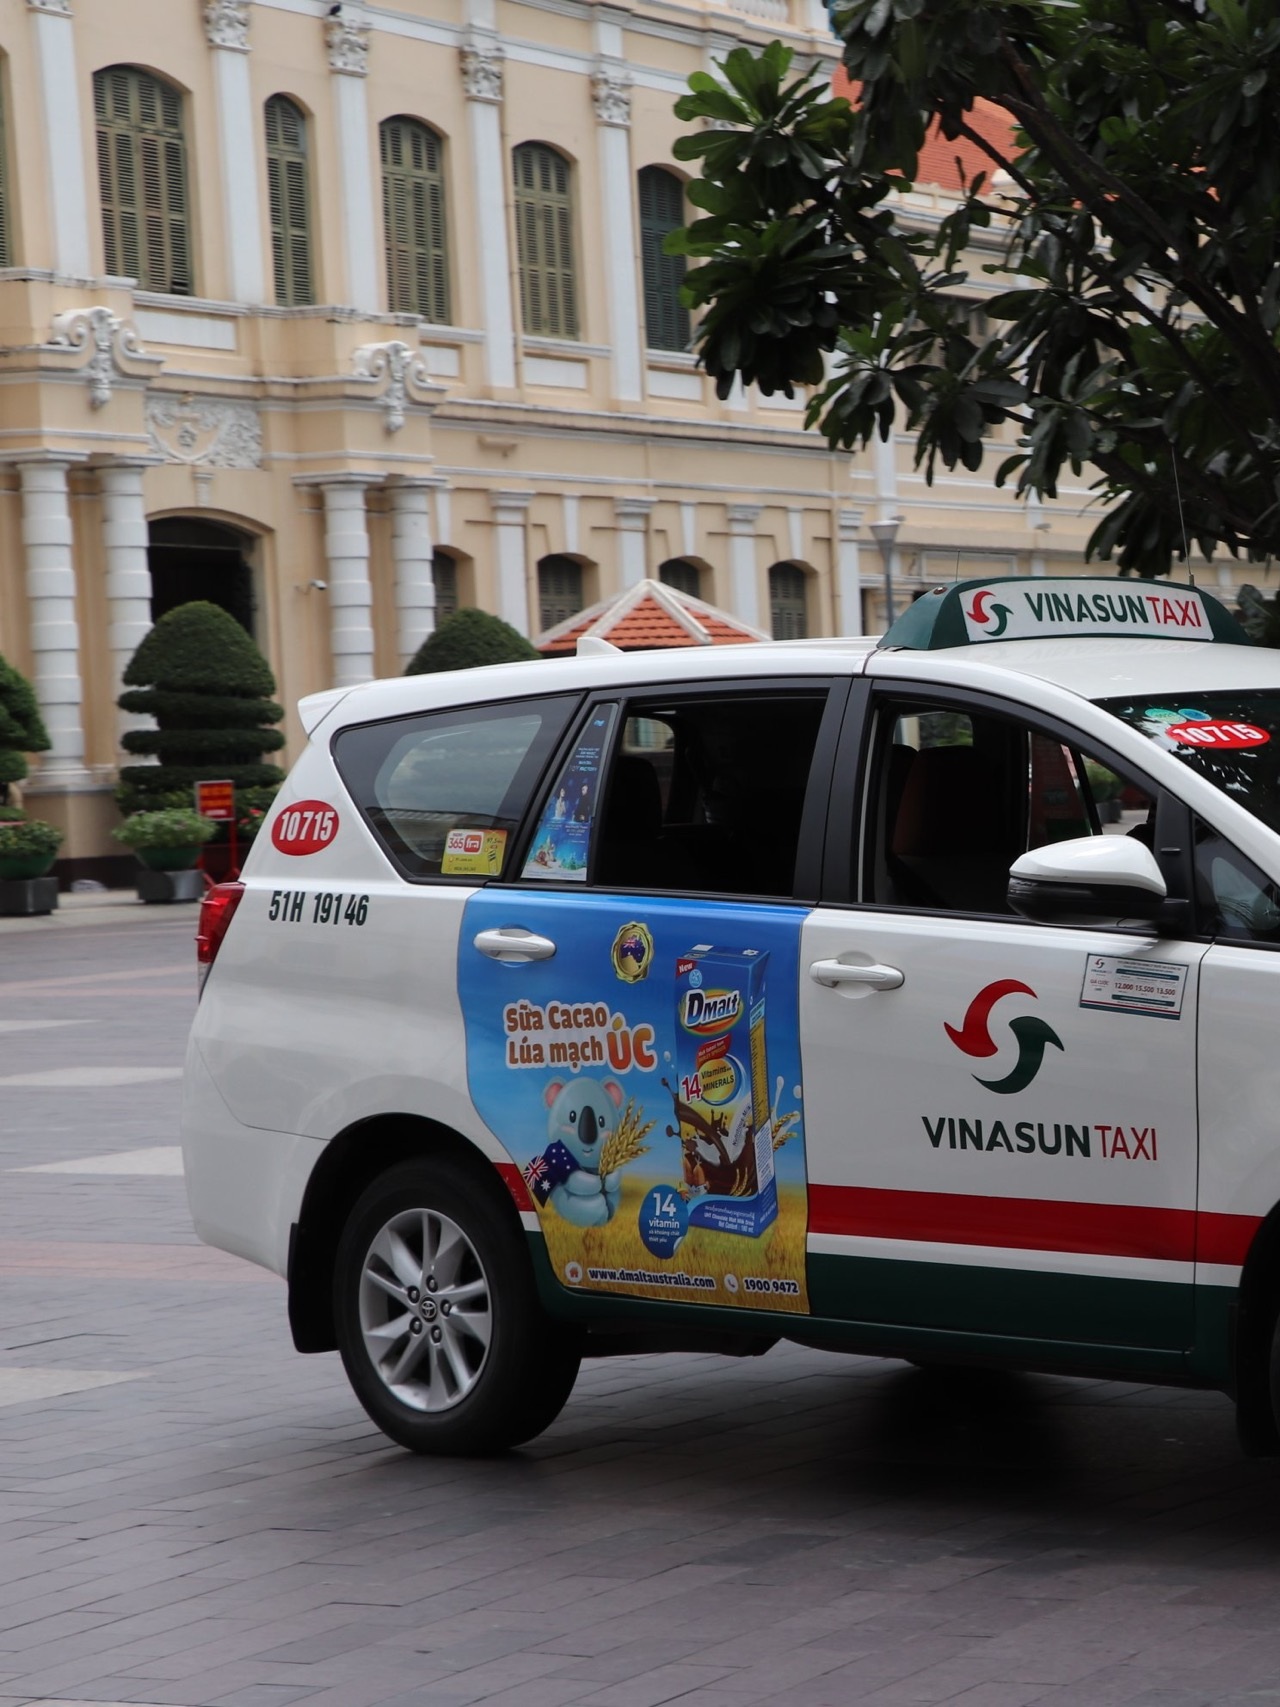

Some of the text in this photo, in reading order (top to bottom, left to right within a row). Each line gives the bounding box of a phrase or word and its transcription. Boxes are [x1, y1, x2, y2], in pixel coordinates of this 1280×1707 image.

[1172, 723, 1260, 745] 10715
[280, 810, 336, 842] 10715
[448, 837, 464, 849] 365
[268, 890, 306, 923] 51H
[678, 962, 693, 973] New
[1114, 982, 1134, 991] 12.000
[506, 1003, 608, 1032] Sữa Cacao
[509, 1016, 655, 1070] Lúa mạch ÚC
[701, 1065, 726, 1079] Vitamins
[703, 1074, 735, 1091] MINERALS
[681, 1073, 702, 1102] 14
[653, 1192, 677, 1217] 14
[648, 1217, 680, 1229] vitamin
[588, 1266, 716, 1289] www.dmaltaustralia.com
[744, 1277, 799, 1294] 1900 9472
